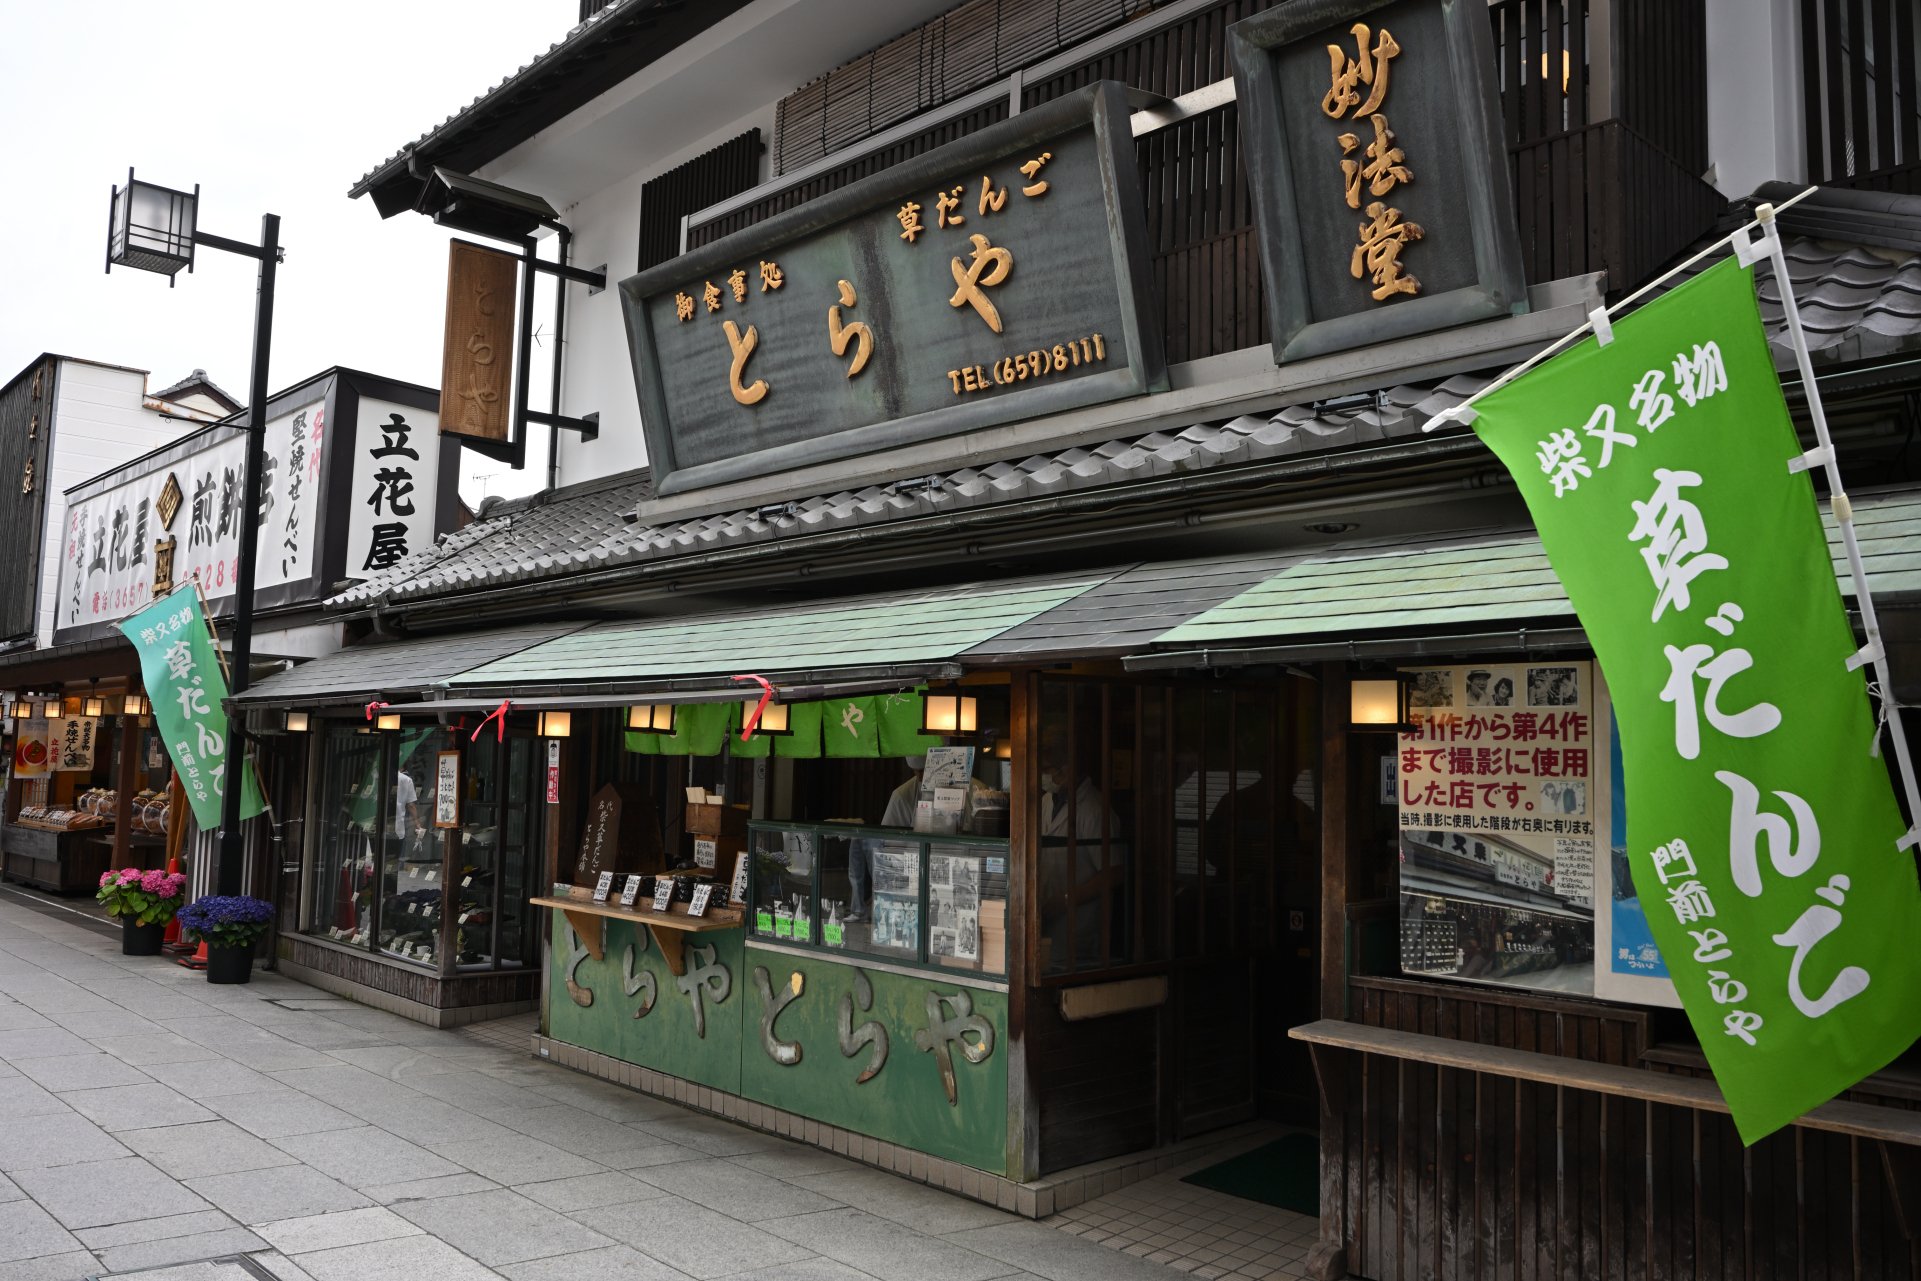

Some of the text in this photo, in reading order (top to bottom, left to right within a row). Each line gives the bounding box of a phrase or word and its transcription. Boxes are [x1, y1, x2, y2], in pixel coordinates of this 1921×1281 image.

[897, 151, 1053, 243] 草だんご
[675, 260, 786, 323] 御食事処
[722, 232, 1015, 406] とらや
[947, 332, 1107, 395] TEL (659)8111
[1535, 340, 1729, 498] 柴又名物
[88, 496, 151, 579] 立花屋
[362, 413, 420, 571] 立花屋
[140, 606, 194, 645] 柴又名物
[1400, 710, 1589, 743] 第1作から第4作
[1400, 746, 1589, 778] まで撮影に使用
[1627, 468, 1871, 1019] 草だんご
[1402, 778, 1535, 812] した店です。
[563, 920, 732, 1040] とらや
[1650, 838, 1764, 1047] 門前とらや
[753, 964, 996, 1107] とらや
